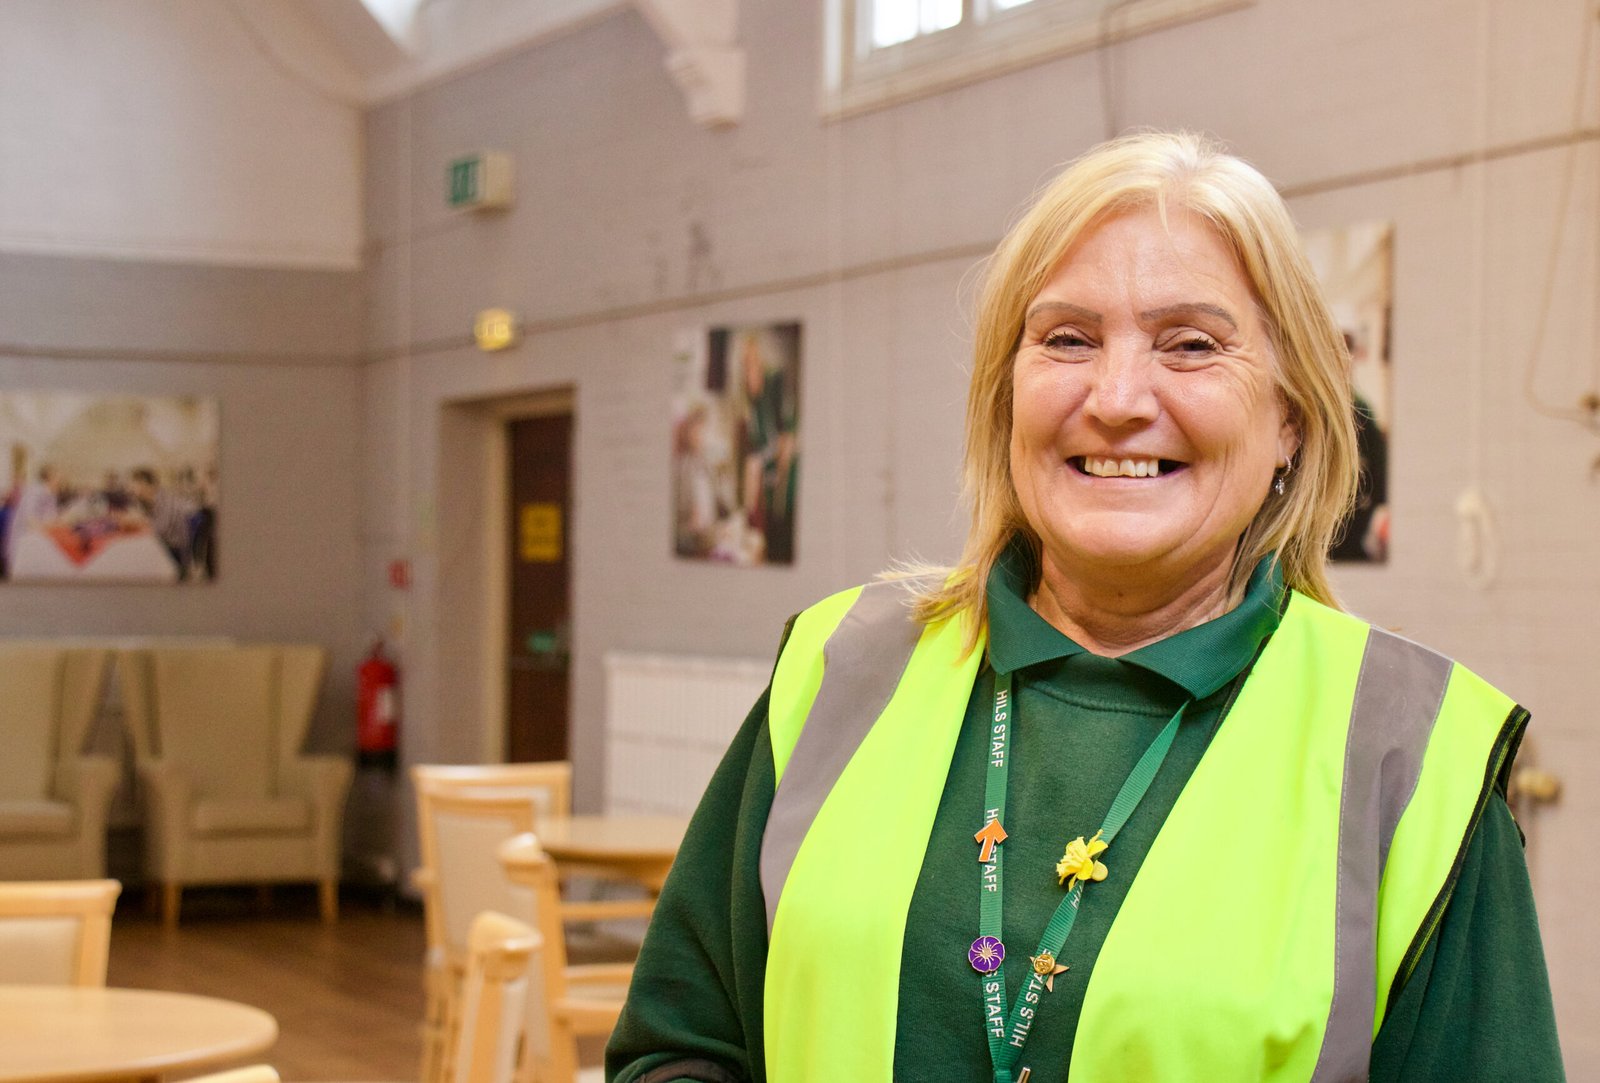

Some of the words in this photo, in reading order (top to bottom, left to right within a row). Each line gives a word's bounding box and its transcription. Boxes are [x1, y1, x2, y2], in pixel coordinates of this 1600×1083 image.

[994, 689, 1008, 723] HILS
[991, 724, 1006, 768] STAFF
[985, 982, 1005, 1038] STAFF
[1009, 1006, 1034, 1048] HILS
[1025, 949, 1051, 1004] STA
